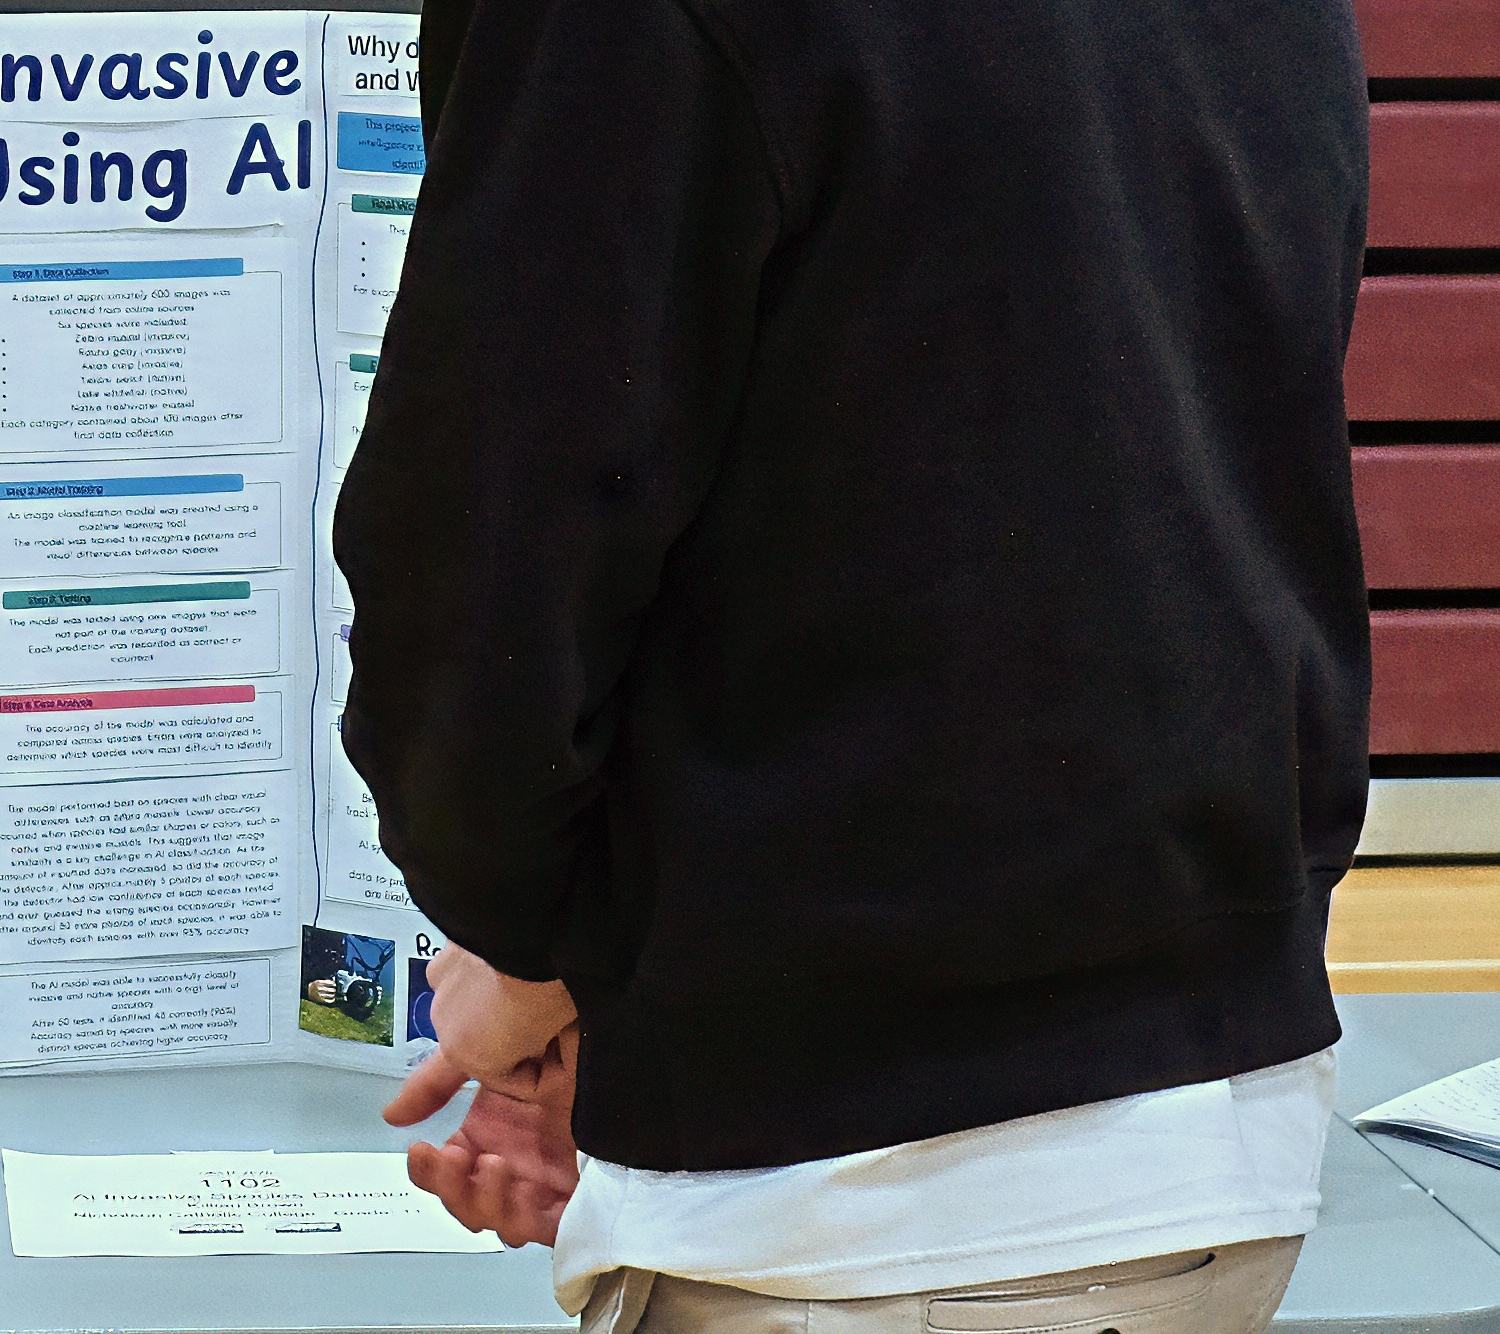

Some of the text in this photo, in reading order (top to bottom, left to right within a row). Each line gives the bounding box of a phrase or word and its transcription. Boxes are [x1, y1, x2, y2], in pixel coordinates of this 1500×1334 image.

[348, 35, 400, 64] Why
[355, 69, 398, 91] and
[226, 119, 312, 196] AI
[200, 1177, 283, 1189] 1102
